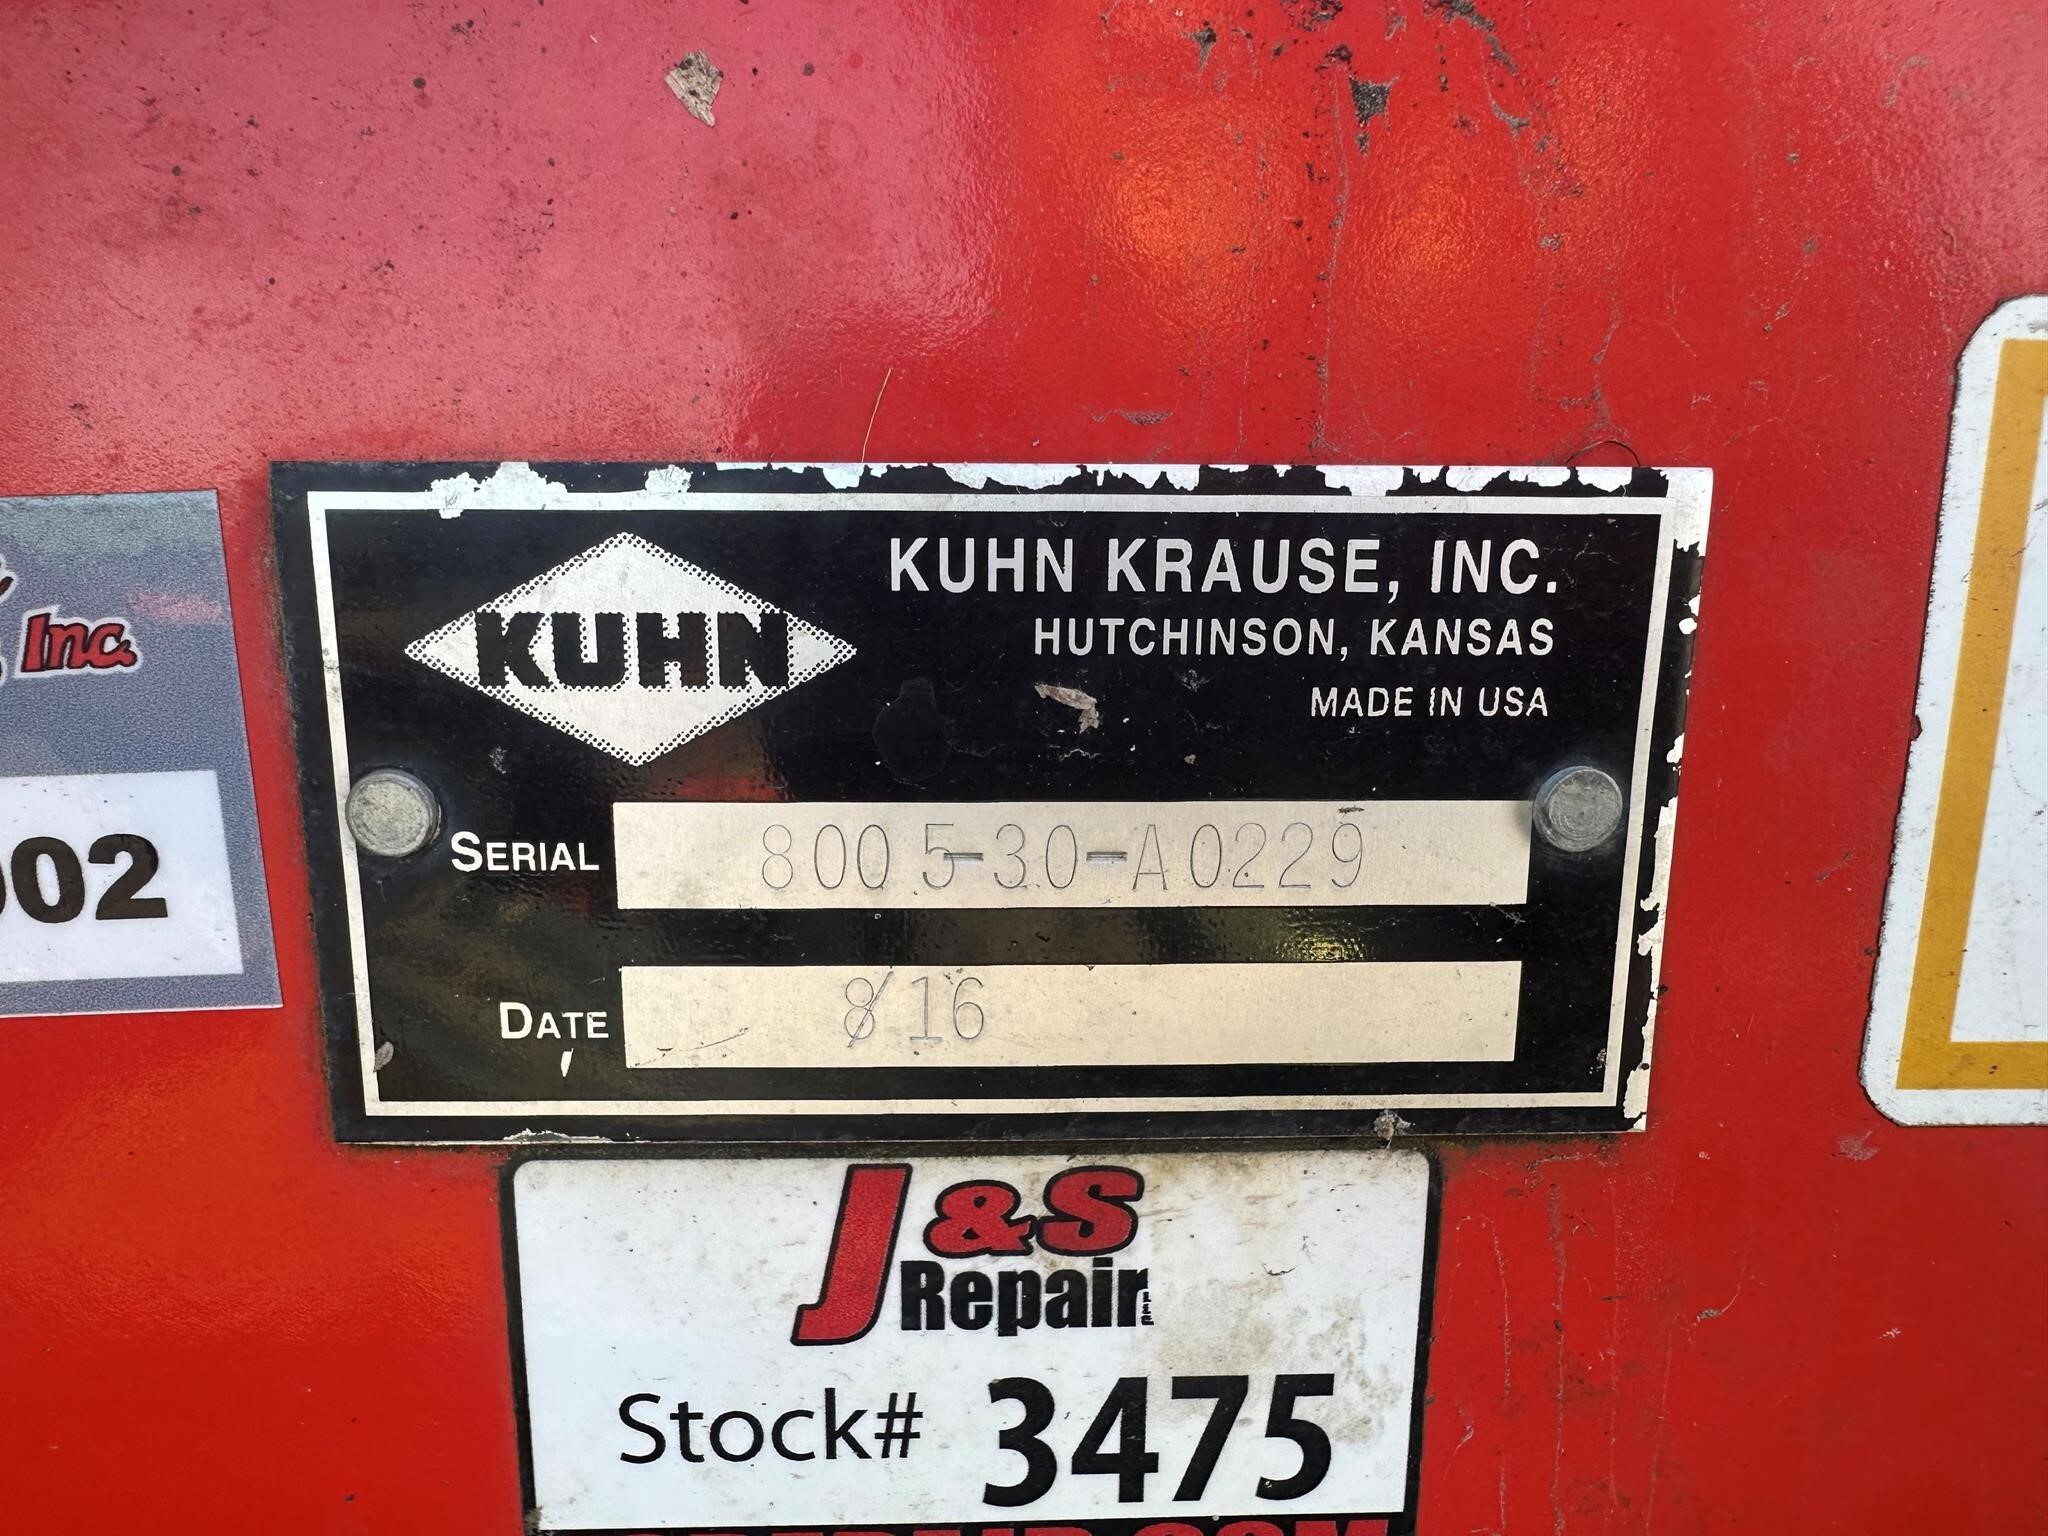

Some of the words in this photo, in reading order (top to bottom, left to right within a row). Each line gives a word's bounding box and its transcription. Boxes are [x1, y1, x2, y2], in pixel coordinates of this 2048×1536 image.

[890, 537, 1074, 594] KUHN
[1107, 537, 1400, 602] KRAUSE,
[1431, 537, 1557, 595] INC.
[476, 611, 789, 688] KUHN
[1034, 617, 1349, 661] HUTCHINSON,
[1369, 617, 1555, 656] KANSAS
[1310, 687, 1414, 718] MADE
[1429, 688, 1463, 717] IN
[1478, 687, 1549, 718] USA
[0, 833, 168, 924] 02
[450, 830, 600, 872] SERIAL
[500, 1001, 610, 1040] DATE
[843, 971, 985, 1048] 8/16
[790, 1163, 1145, 1346] J&S
[901, 1257, 1149, 1337] Repair
[618, 1387, 925, 1464] Stock#
[982, 1373, 1336, 1508] 3475
